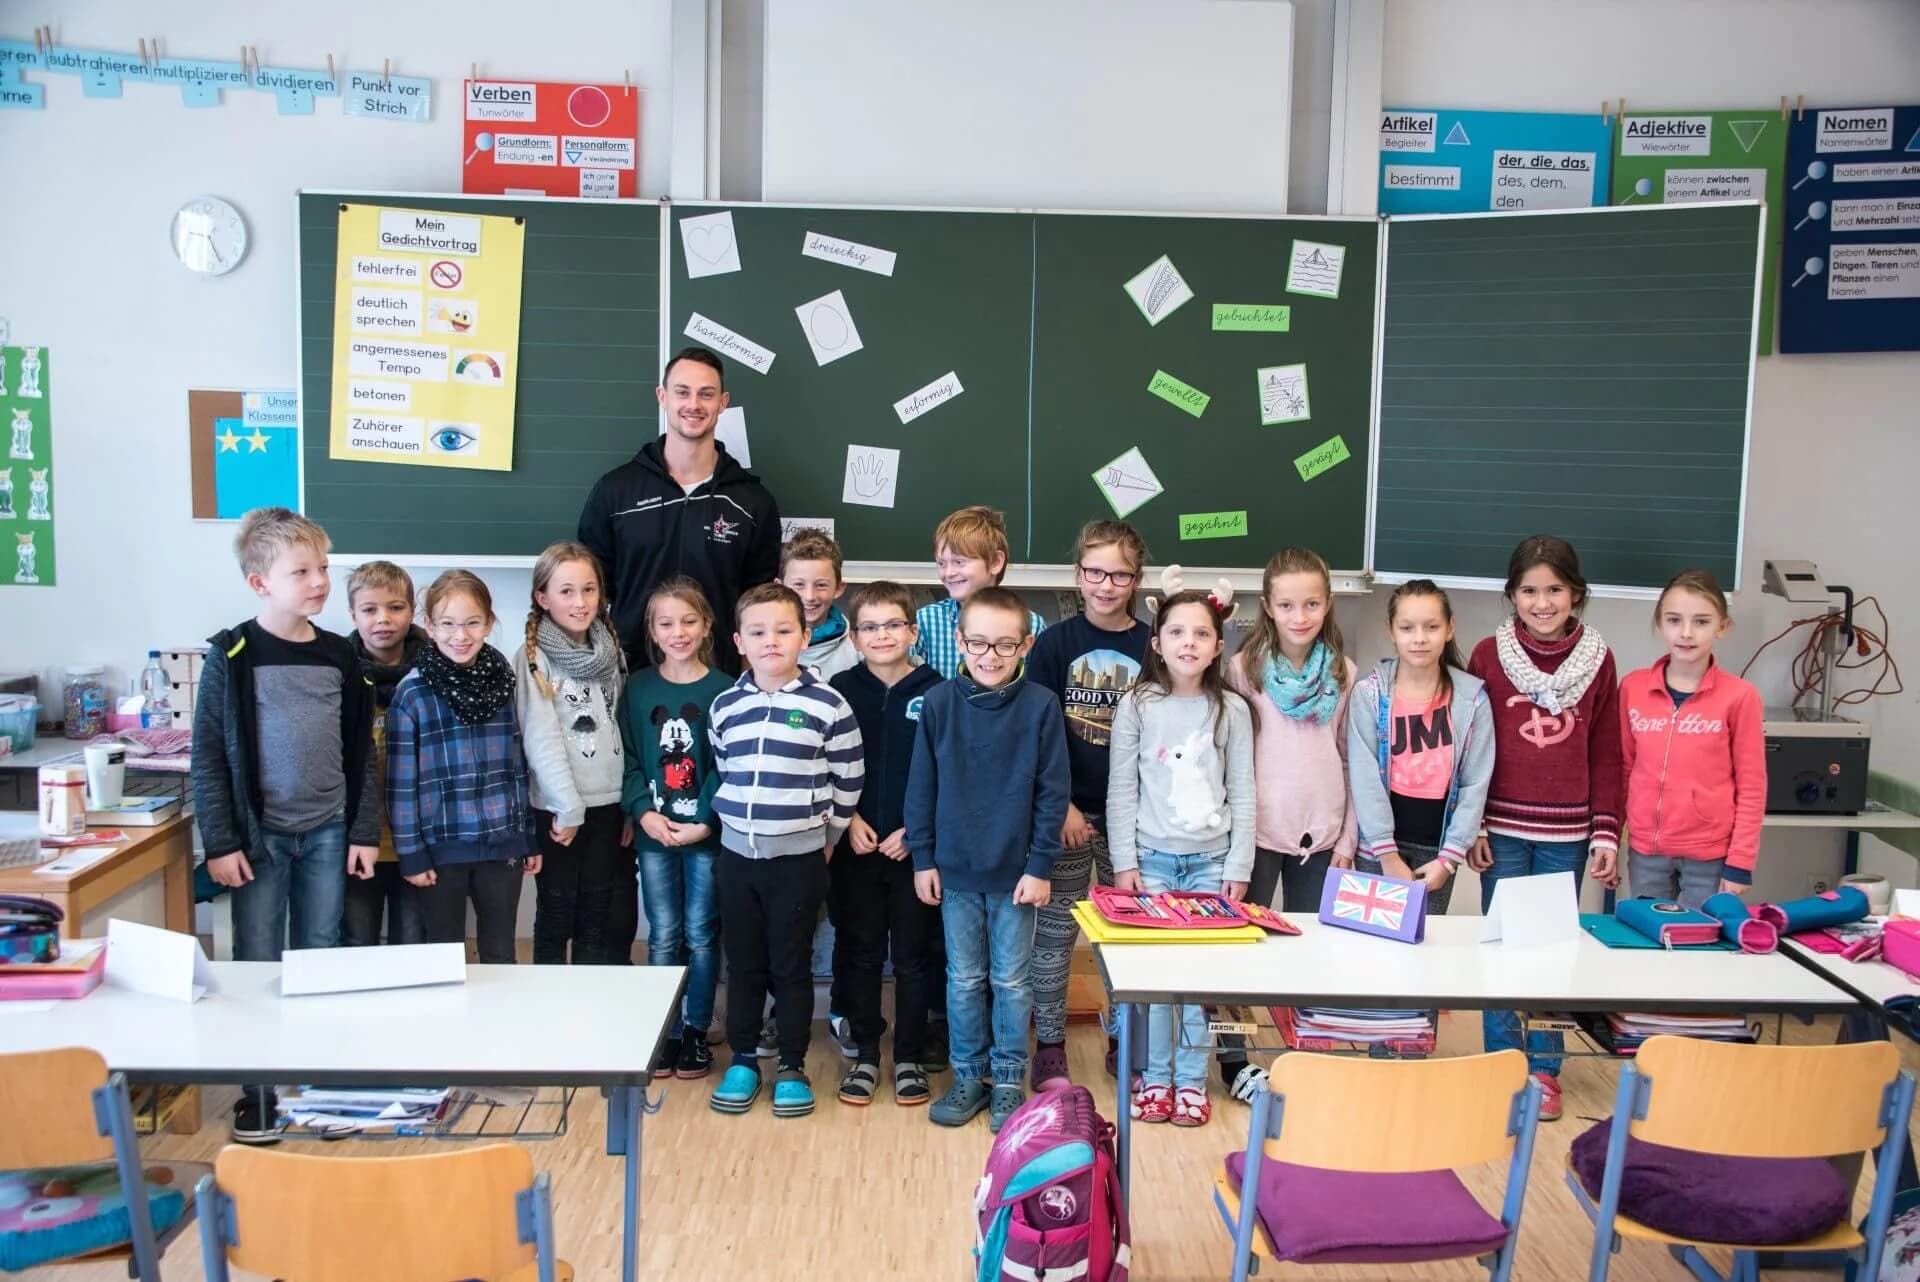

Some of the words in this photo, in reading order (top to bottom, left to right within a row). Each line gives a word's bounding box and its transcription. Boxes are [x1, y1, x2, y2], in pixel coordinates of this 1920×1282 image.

[49, 52, 148, 76] subtrahieren
[153, 65, 248, 84] multiplizieren
[256, 71, 335, 92] dividieren
[352, 77, 392, 94] Punkt
[398, 86, 421, 97] vor
[472, 86, 531, 102] Verben
[365, 99, 408, 115] Strich
[478, 108, 525, 119] Tunwörter
[1381, 116, 1433, 132] Artikel
[1626, 120, 1706, 138] Adjektive
[1824, 115, 1887, 130] Nomen
[498, 136, 553, 147] Grundform:
[564, 139, 630, 150] Personalform:
[1385, 137, 1426, 148] Begleiter
[1642, 142, 1690, 152] Wiewörter
[498, 151, 534, 162] Endung
[1499, 154, 1525, 169] der,
[1530, 155, 1555, 169] die,
[1561, 155, 1590, 170] das,
[1390, 172, 1455, 187] bestimmt
[1498, 175, 1525, 188] des,
[1530, 176, 1567, 189] dem,
[1706, 175, 1750, 184] zwischen
[1700, 188, 1730, 197] Artikel
[1496, 194, 1524, 208] den
[415, 217, 445, 231] Mein
[1856, 216, 1899, 225] Mehrzahl
[381, 232, 477, 253] Gedichtvortrag
[810, 237, 871, 266] dreieckig
[357, 262, 417, 277] fehlerfrei
[357, 296, 408, 310] deutlich
[356, 314, 416, 328] sprechen
[1216, 309, 1287, 326] gebuchtet
[352, 343, 448, 360] angemessenes
[377, 360, 421, 375] Tempo
[353, 387, 406, 402] betonen
[1153, 376, 1204, 407] gewellt
[352, 418, 404, 433] Zuhörer
[352, 437, 420, 452] anschauen
[1184, 517, 1242, 536] gezähnt
[1065, 689, 1102, 704] GOOD
